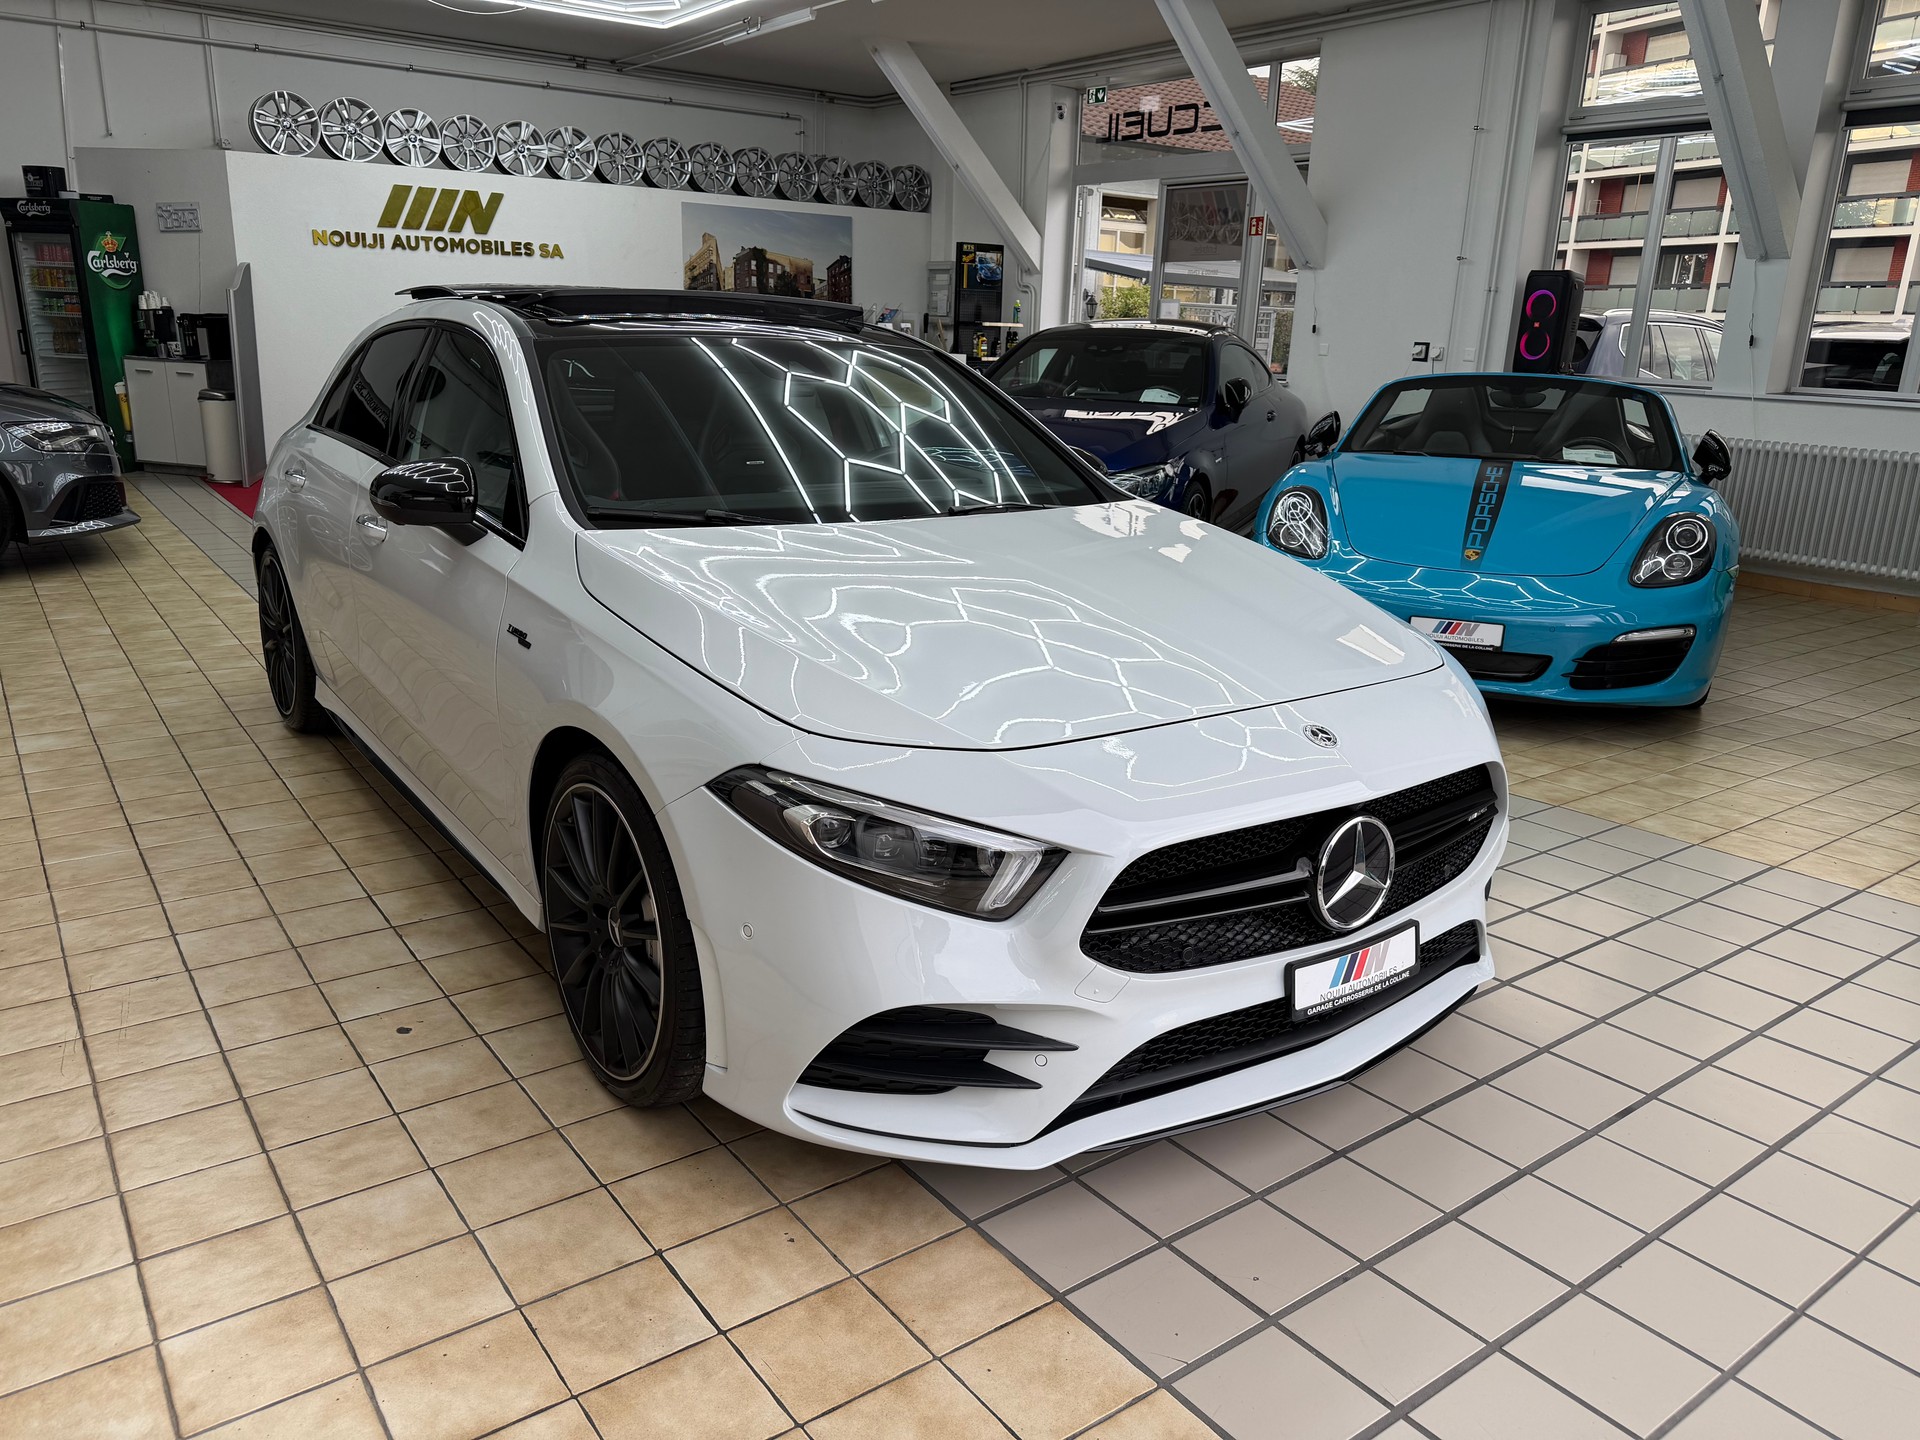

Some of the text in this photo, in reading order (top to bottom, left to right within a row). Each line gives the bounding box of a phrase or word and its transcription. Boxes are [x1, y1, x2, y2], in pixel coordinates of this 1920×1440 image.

[17, 200, 50, 216] Carlsberg
[312, 229, 564, 259] NOUIJI AUTOMOBILES SA
[87, 250, 138, 277] Carlsberg
[1466, 467, 1504, 549] PORSCHE
[1307, 970, 1410, 1015] GARAGE CARROSSERIE DE LA COLLINE
[1348, 966, 1397, 993] AUTOMOBILES
